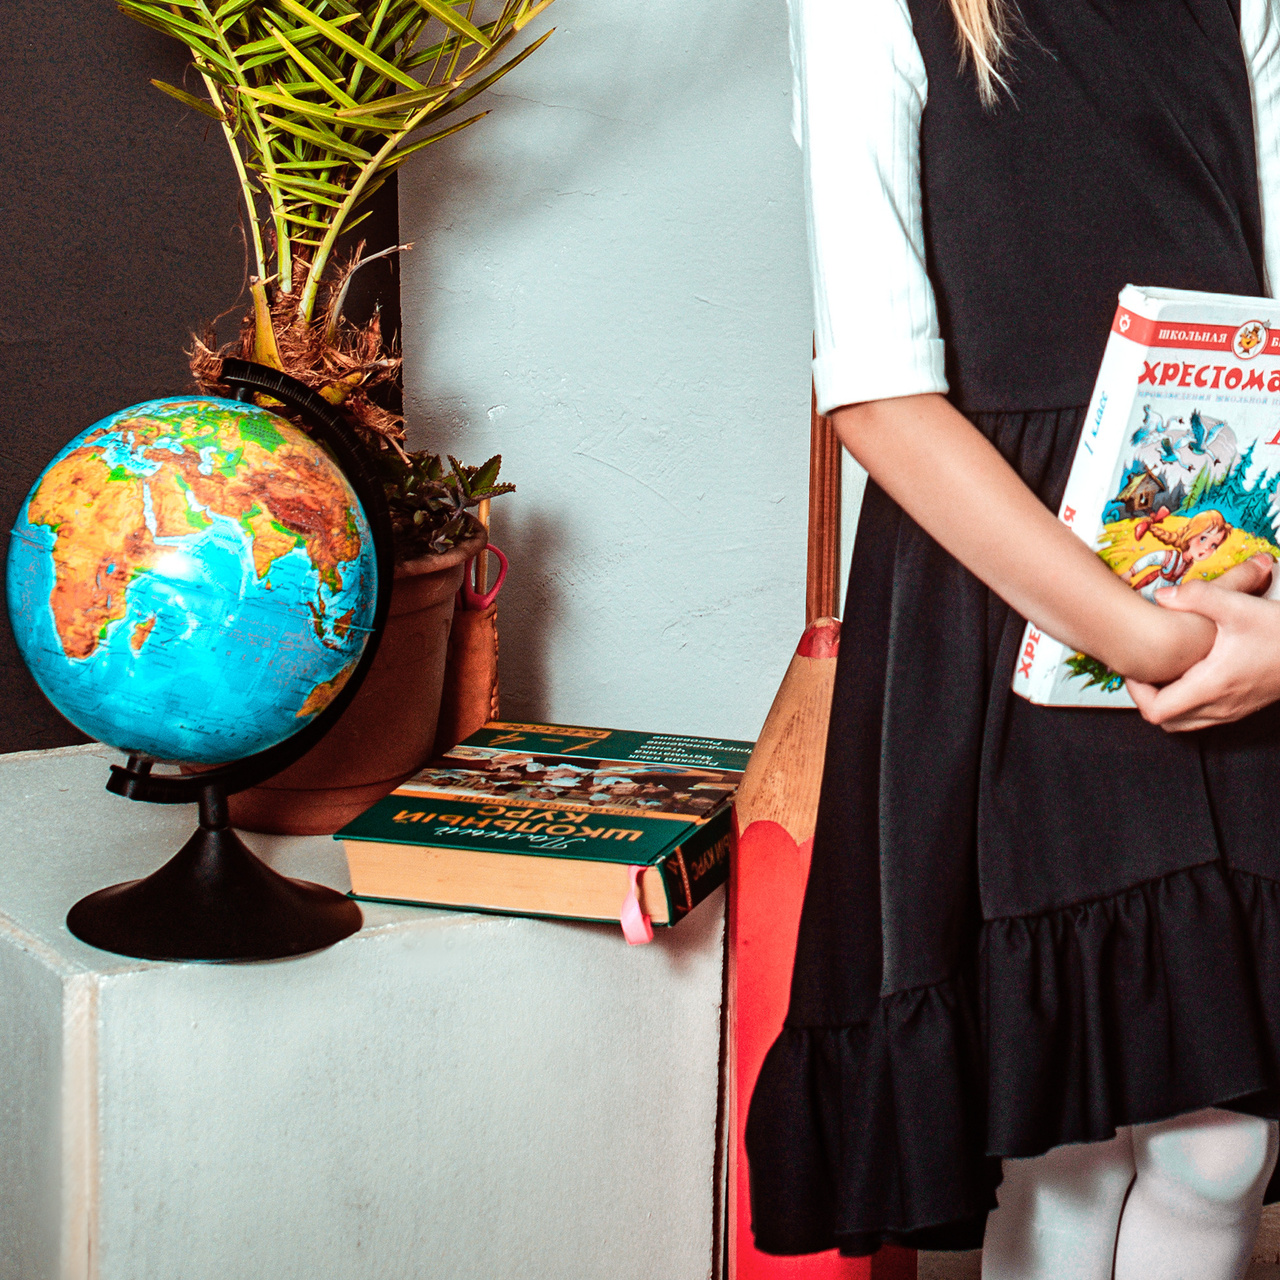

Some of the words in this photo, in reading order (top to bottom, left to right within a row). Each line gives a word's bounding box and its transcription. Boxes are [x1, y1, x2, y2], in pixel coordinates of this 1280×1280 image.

[1158, 329, 1227, 345] ШКОЛЬНАЯ
[1215, 395, 1268, 405] ШКОЛЬНОЙ
[652, 735, 722, 746] Рисование
[634, 750, 713, 760] Математика
[476, 805, 590, 824] КУРС
[392, 809, 644, 842] ШКОЛЬНЫЙ
[433, 826, 587, 850] Полный
